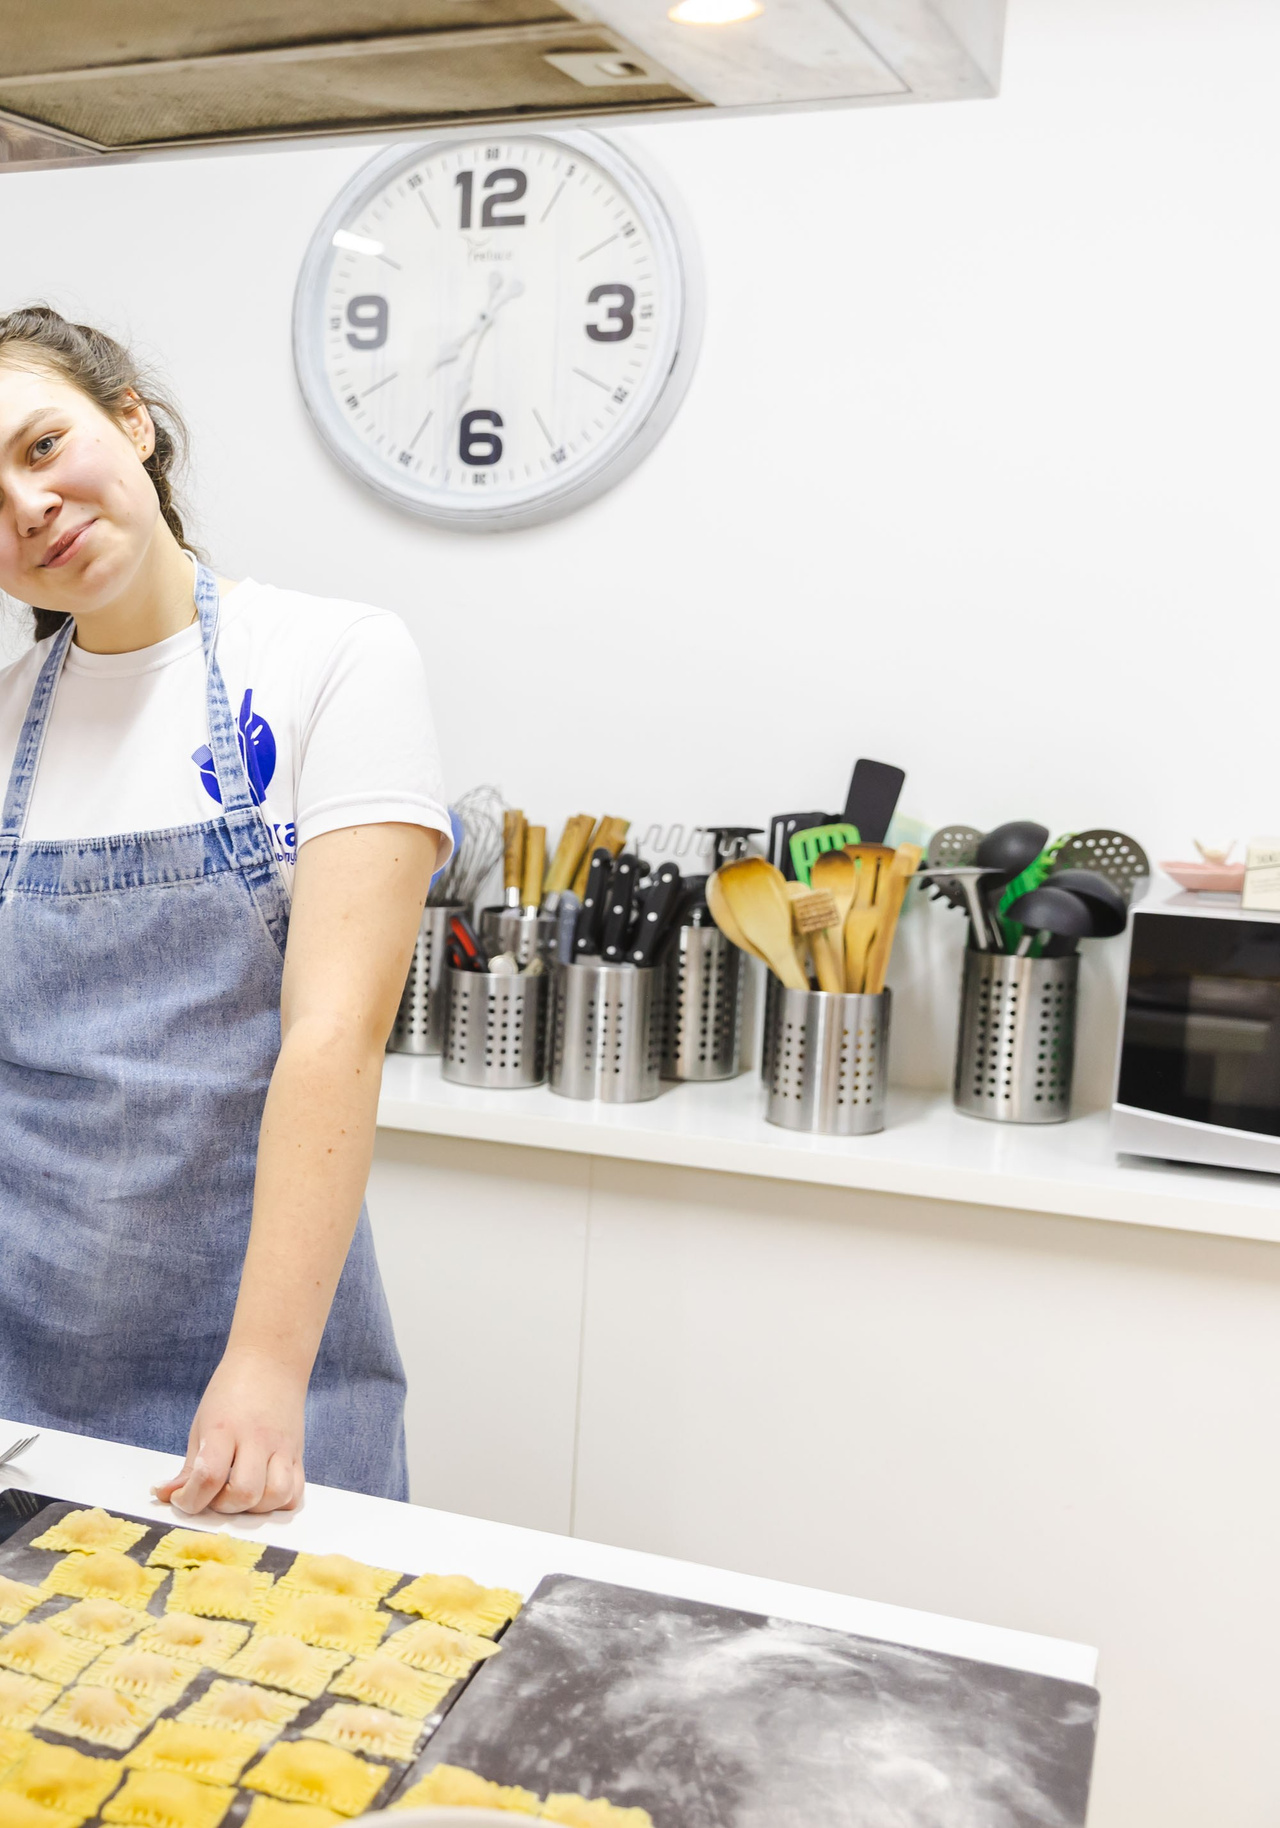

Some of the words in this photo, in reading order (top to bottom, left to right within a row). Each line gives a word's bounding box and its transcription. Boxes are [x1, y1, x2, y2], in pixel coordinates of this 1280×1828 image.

[455, 168, 527, 229] 12
[346, 295, 389, 350] 9
[585, 282, 636, 343] 3
[459, 409, 504, 466] 6
